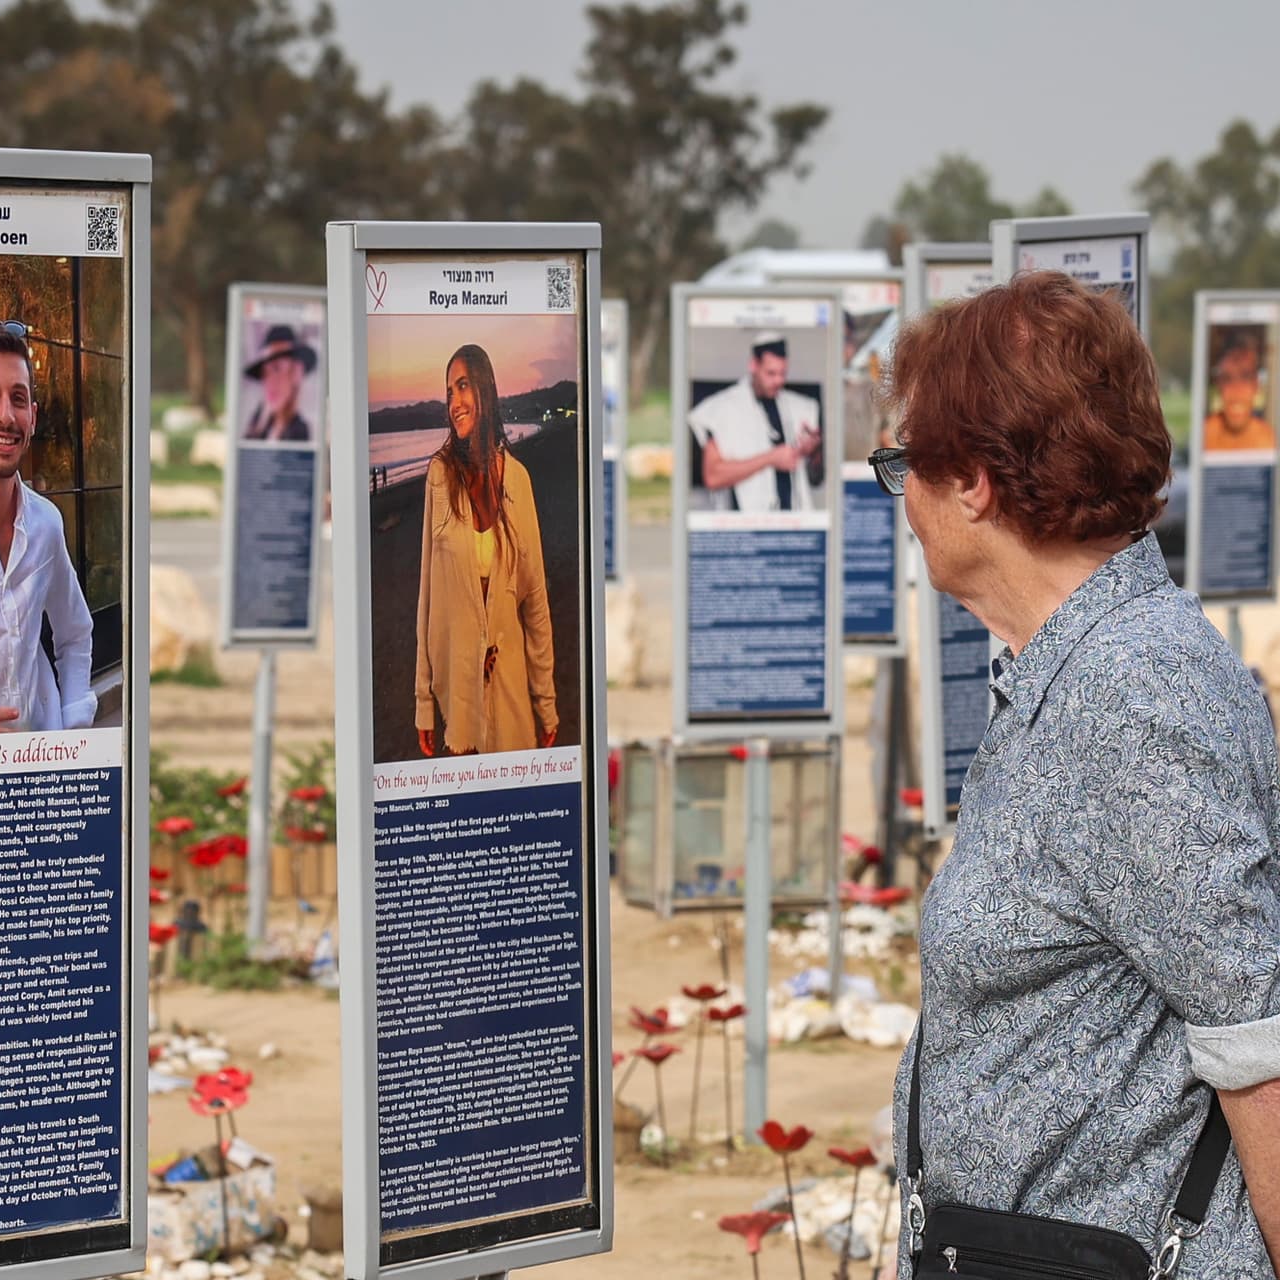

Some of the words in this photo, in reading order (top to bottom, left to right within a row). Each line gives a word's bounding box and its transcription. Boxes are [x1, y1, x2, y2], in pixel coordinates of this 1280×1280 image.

[442, 270, 471, 282] מנצורי
[474, 270, 493, 282] רויה
[429, 290, 457, 308] Roya
[462, 290, 507, 304] Manzuri
[12, 739, 86, 763] addictive”
[23, 773, 60, 784] tragically
[61, 770, 98, 781] murdered
[100, 770, 109, 780] by
[392, 769, 408, 788] the
[408, 774, 429, 792] way
[430, 766, 456, 784] home
[456, 770, 475, 790] you
[476, 762, 498, 780] have
[500, 766, 509, 778] to
[510, 764, 529, 778] stop
[530, 757, 542, 779] by
[544, 756, 557, 774] the
[558, 756, 578, 772] sea”
[389, 802, 414, 811] Manzuri,
[415, 800, 429, 809] 2001
[434, 798, 449, 807] 2023
[380, 1146, 404, 1156] October
[404, 1142, 420, 1151] 12th,
[420, 1140, 438, 1149] 2023.
[0, 1218, 27, 1228] hearts.
